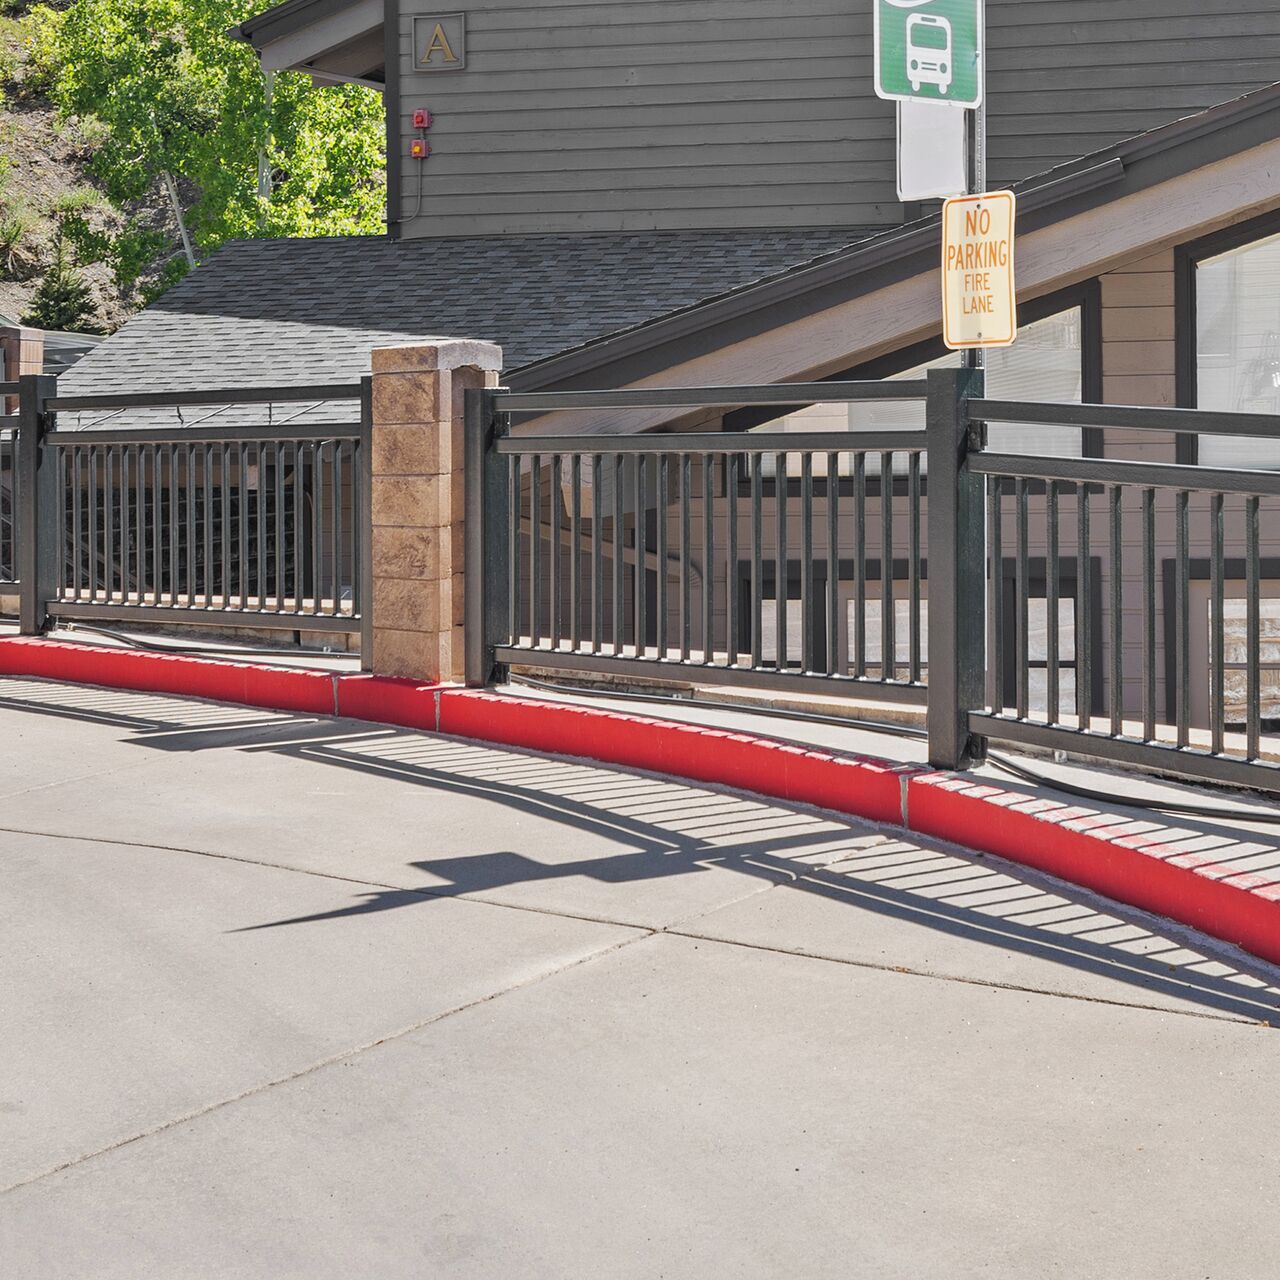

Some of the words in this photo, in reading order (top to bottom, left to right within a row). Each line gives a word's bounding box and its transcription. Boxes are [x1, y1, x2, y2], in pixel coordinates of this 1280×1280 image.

[420, 22, 459, 63] A
[965, 208, 991, 237] NO
[947, 239, 1008, 271] PARKING
[964, 272, 991, 291] FIRE
[963, 295, 995, 315] LANE
